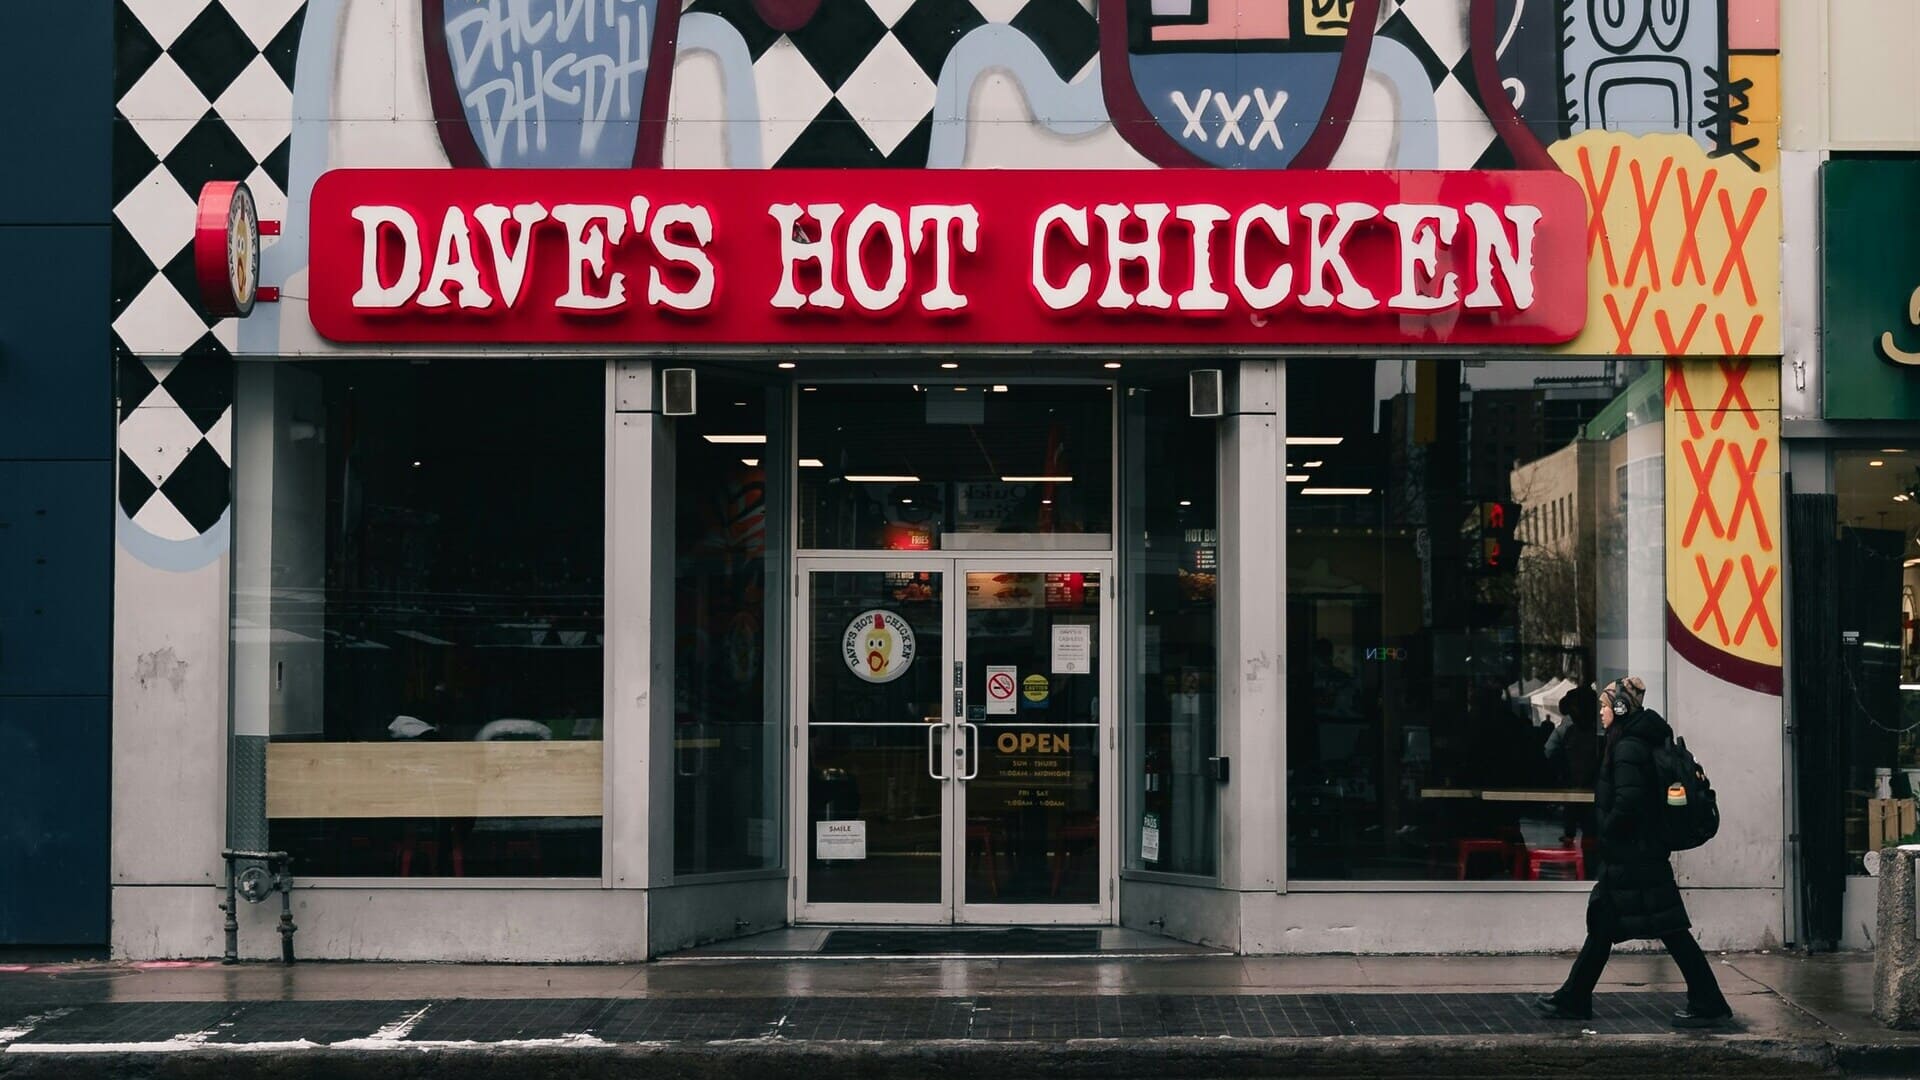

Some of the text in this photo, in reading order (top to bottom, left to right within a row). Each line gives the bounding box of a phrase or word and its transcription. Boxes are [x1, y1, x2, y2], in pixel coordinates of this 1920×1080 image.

[351, 195, 1543, 311] DAVE'S HOT CHICKEN
[1184, 528, 1202, 543] HOT
[846, 614, 912, 667] DAVE'S HOT CHICKEN
[997, 732, 1070, 753] OPEN
